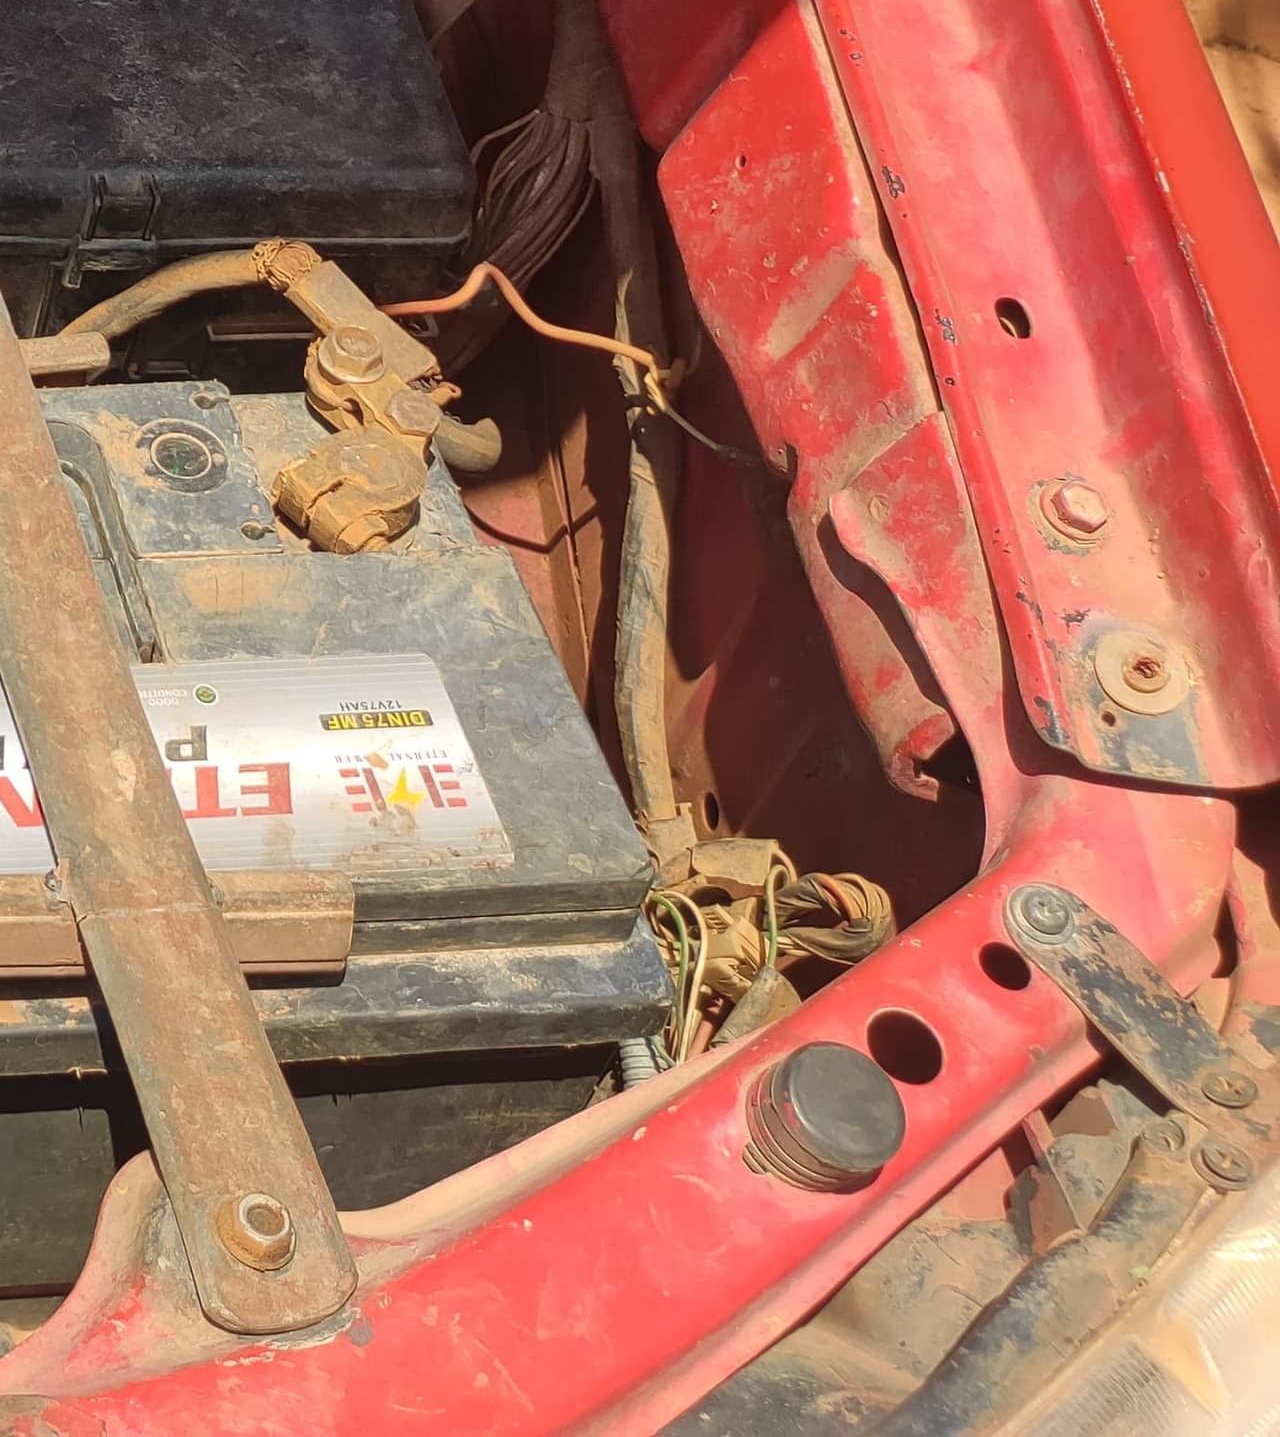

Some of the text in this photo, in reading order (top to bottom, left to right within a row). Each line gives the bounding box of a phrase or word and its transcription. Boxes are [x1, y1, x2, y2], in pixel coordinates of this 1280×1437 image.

[148, 697, 179, 706] GOOD
[340, 699, 403, 712] 12V75AH
[327, 711, 426, 729] DIN75 MF
